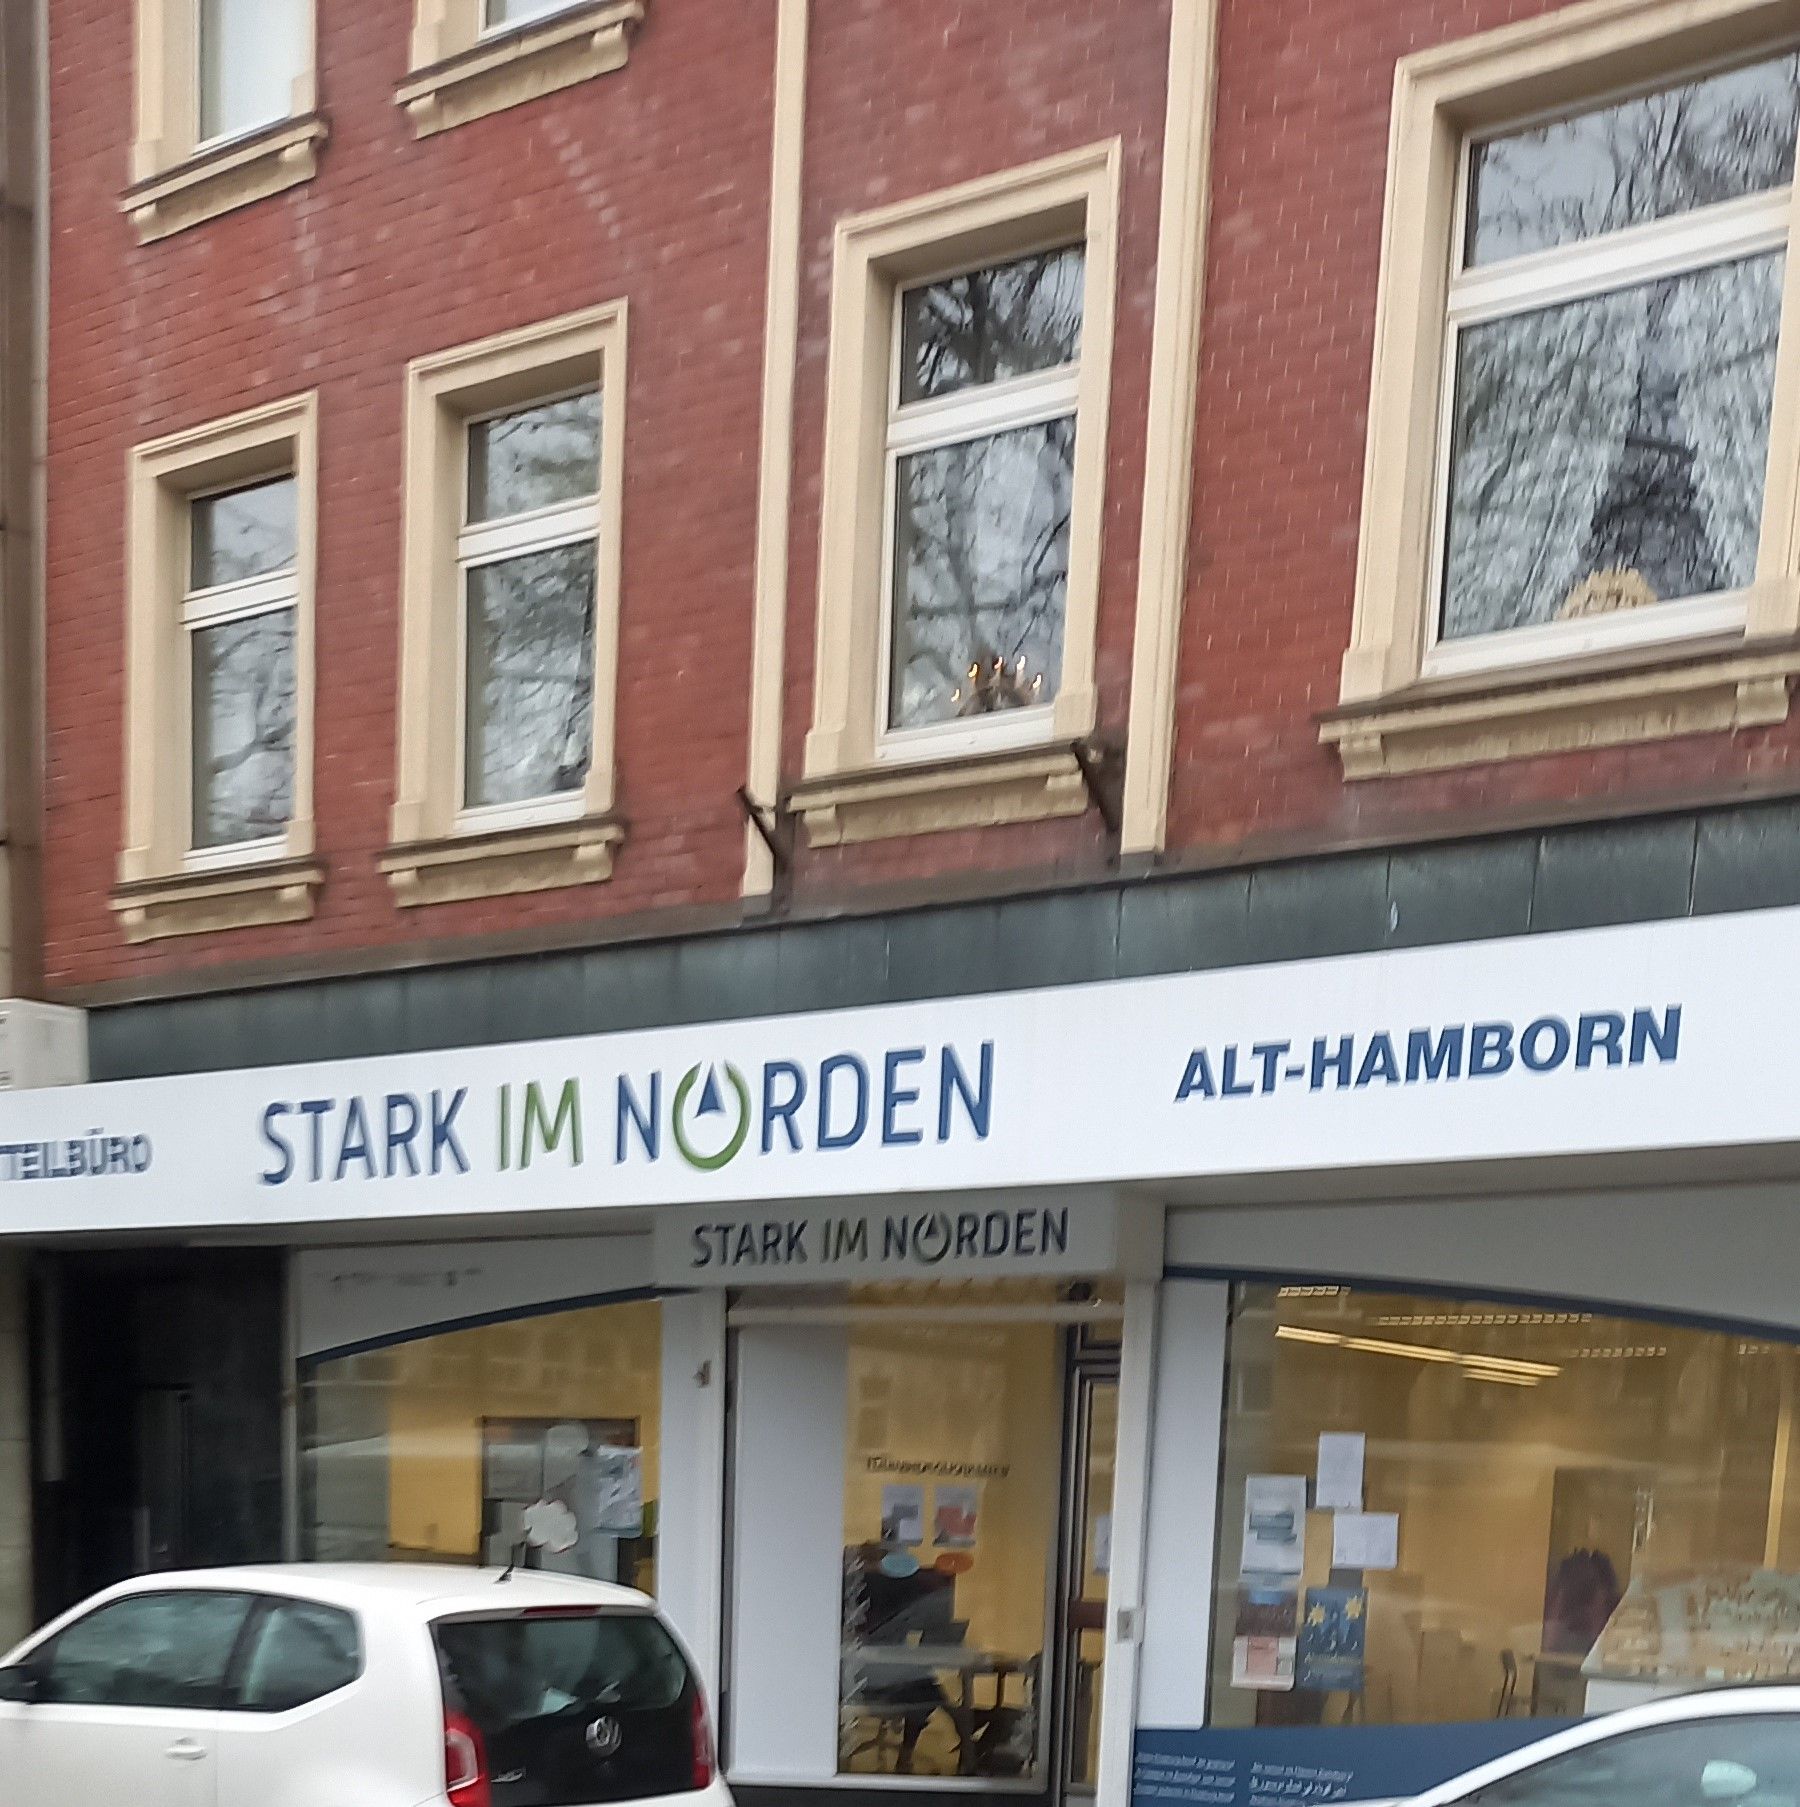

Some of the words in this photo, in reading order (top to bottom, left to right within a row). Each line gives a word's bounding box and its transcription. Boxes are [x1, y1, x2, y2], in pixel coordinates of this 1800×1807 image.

[1174, 1003, 1682, 1104] ALT-HAMBORN
[258, 1087, 470, 1185] STARK
[496, 1077, 584, 1172] IM
[615, 1040, 994, 1172] NORDEN
[691, 1220, 808, 1268] STARK
[819, 1216, 868, 1262] IM
[881, 1206, 1069, 1265] NORDEN
